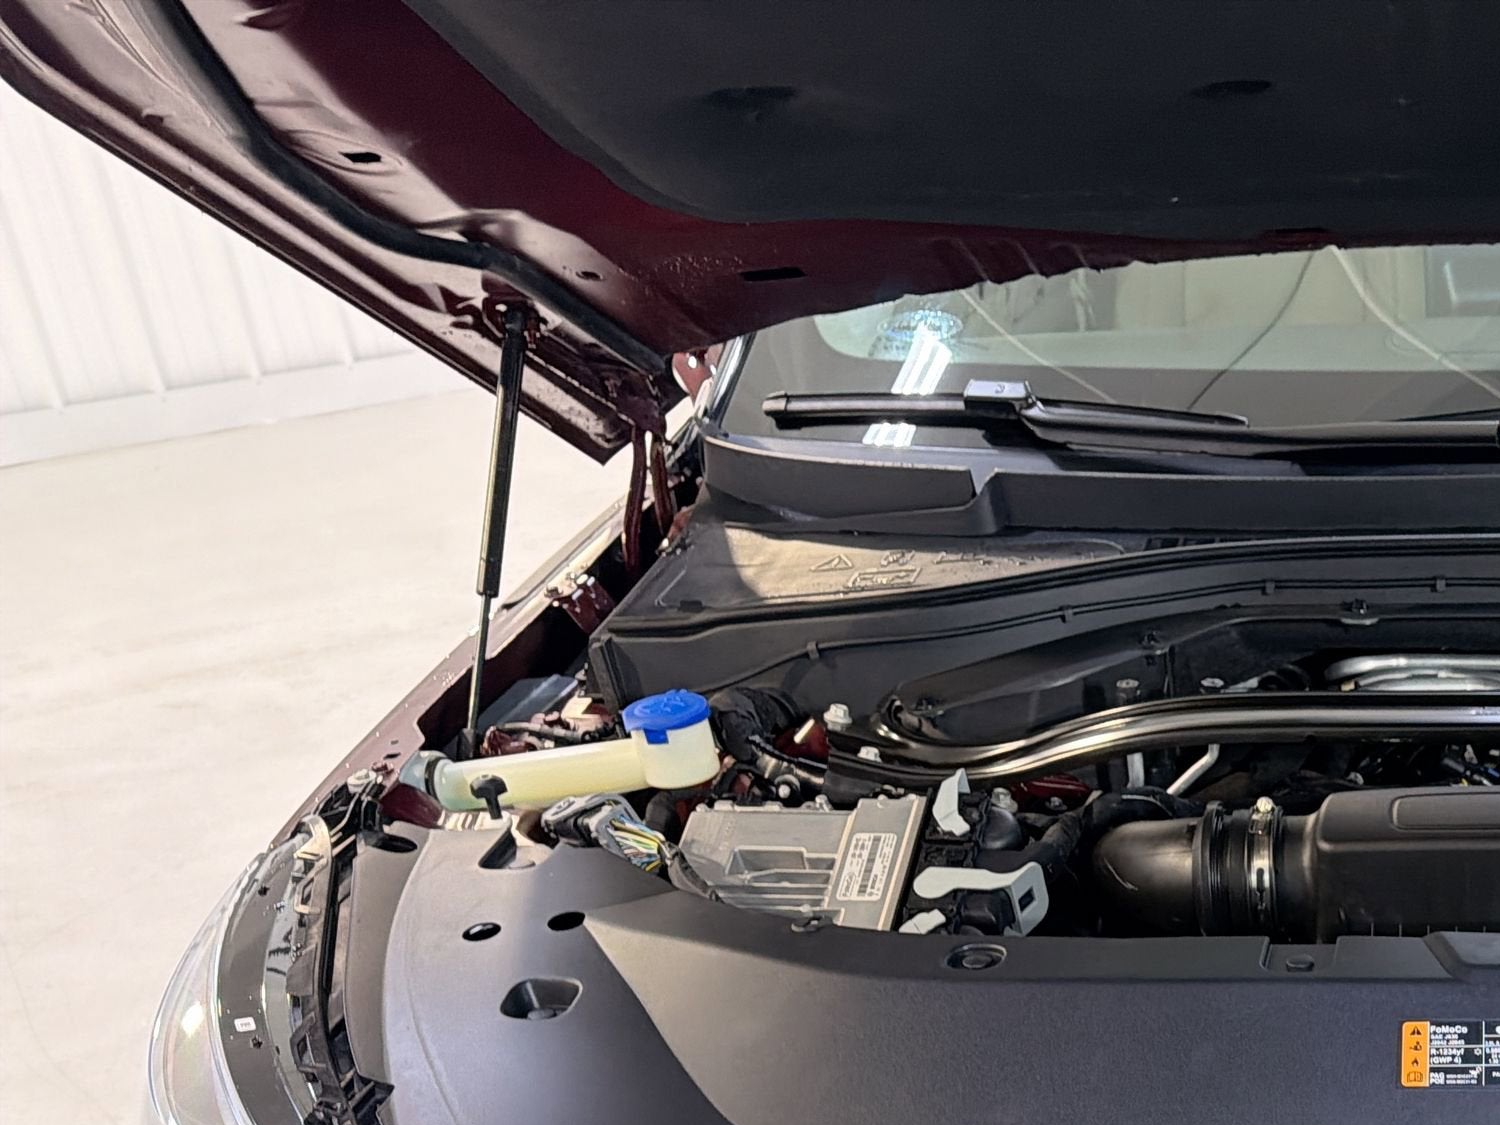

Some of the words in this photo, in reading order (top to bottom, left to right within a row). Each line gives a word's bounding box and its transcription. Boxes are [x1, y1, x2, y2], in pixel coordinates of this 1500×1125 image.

[1430, 1025, 1468, 1034] FoMoCo
[1430, 1048, 1465, 1056] R-1234yf
[1430, 1056, 1453, 1065] (GWP
